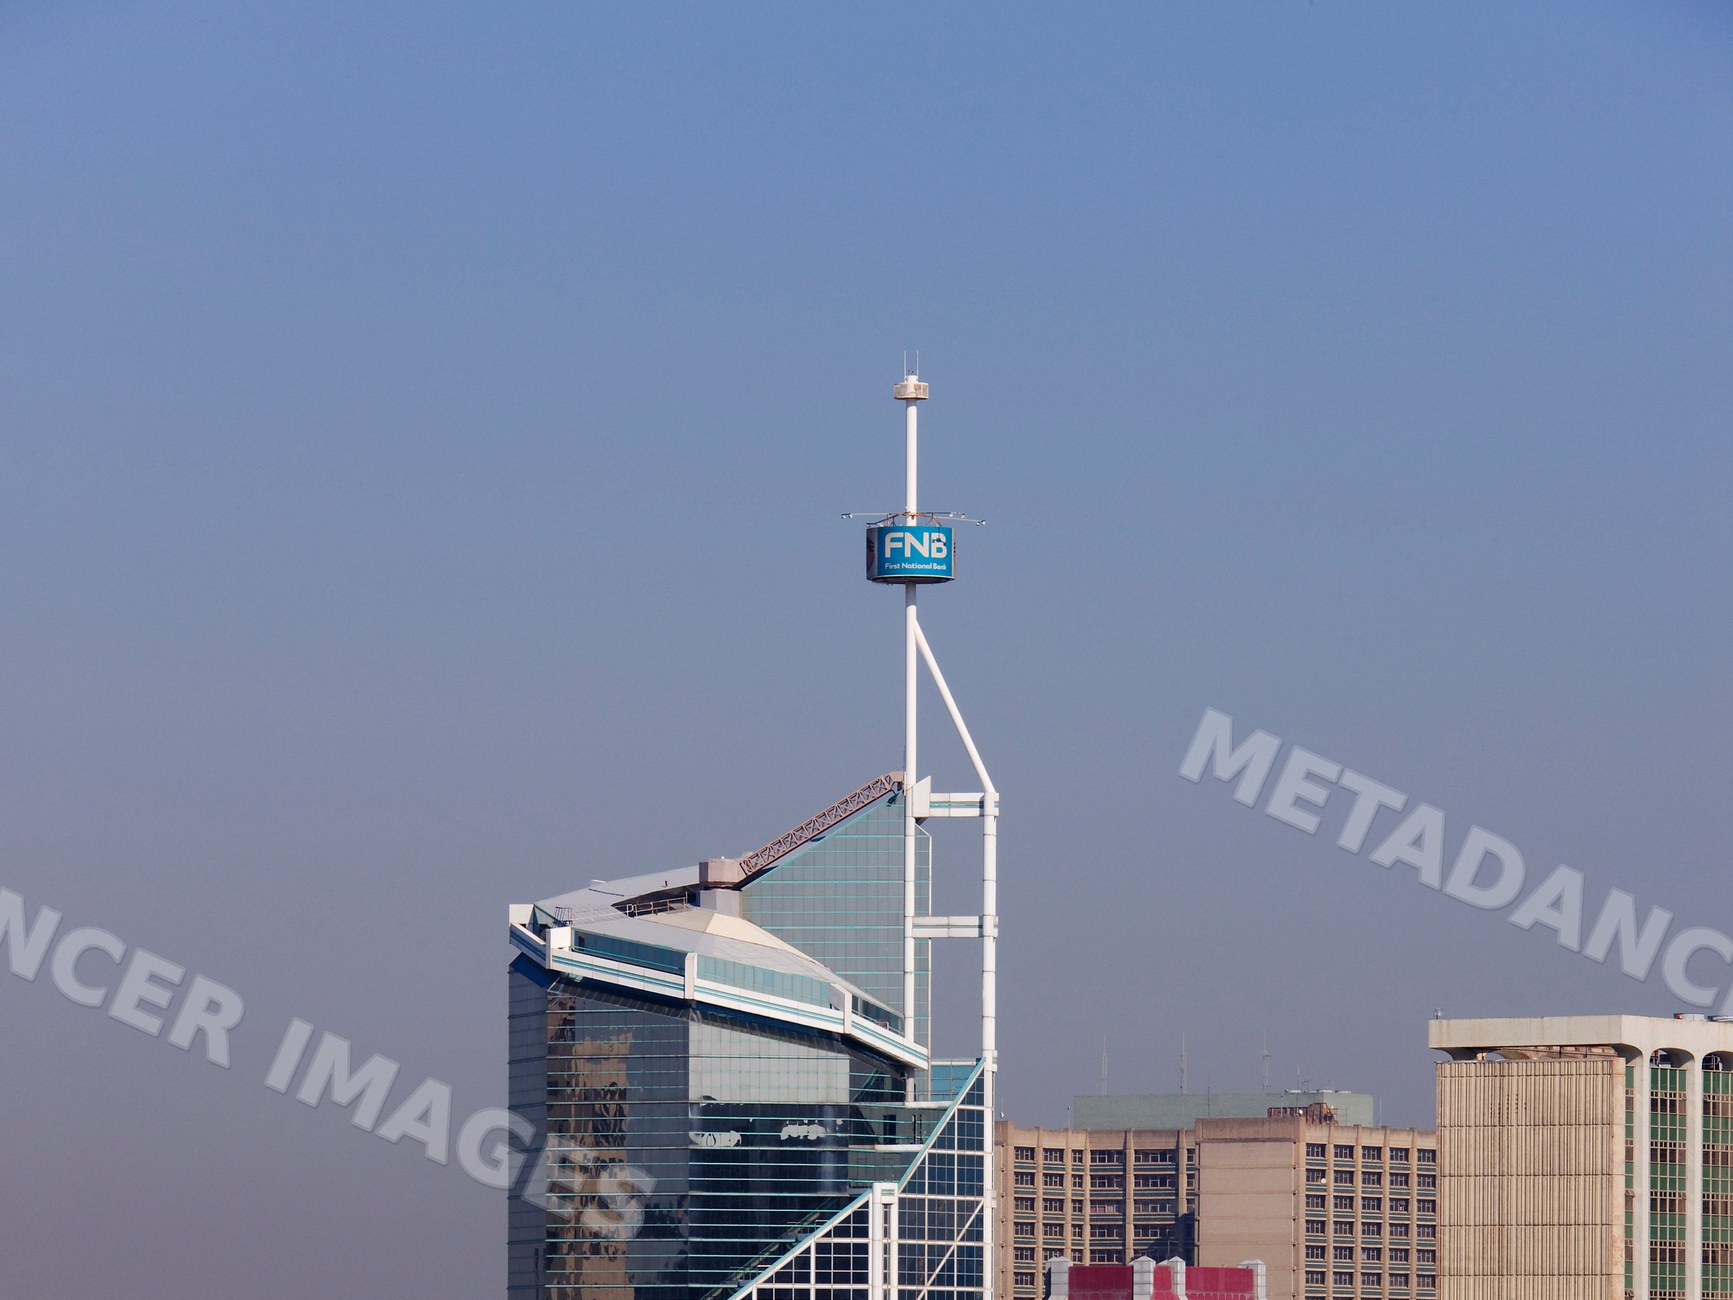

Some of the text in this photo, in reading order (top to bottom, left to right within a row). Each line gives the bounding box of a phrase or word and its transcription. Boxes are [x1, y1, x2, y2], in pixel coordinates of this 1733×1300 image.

[885, 532, 947, 558] FNB
[885, 562, 900, 570] First
[902, 562, 932, 570] National
